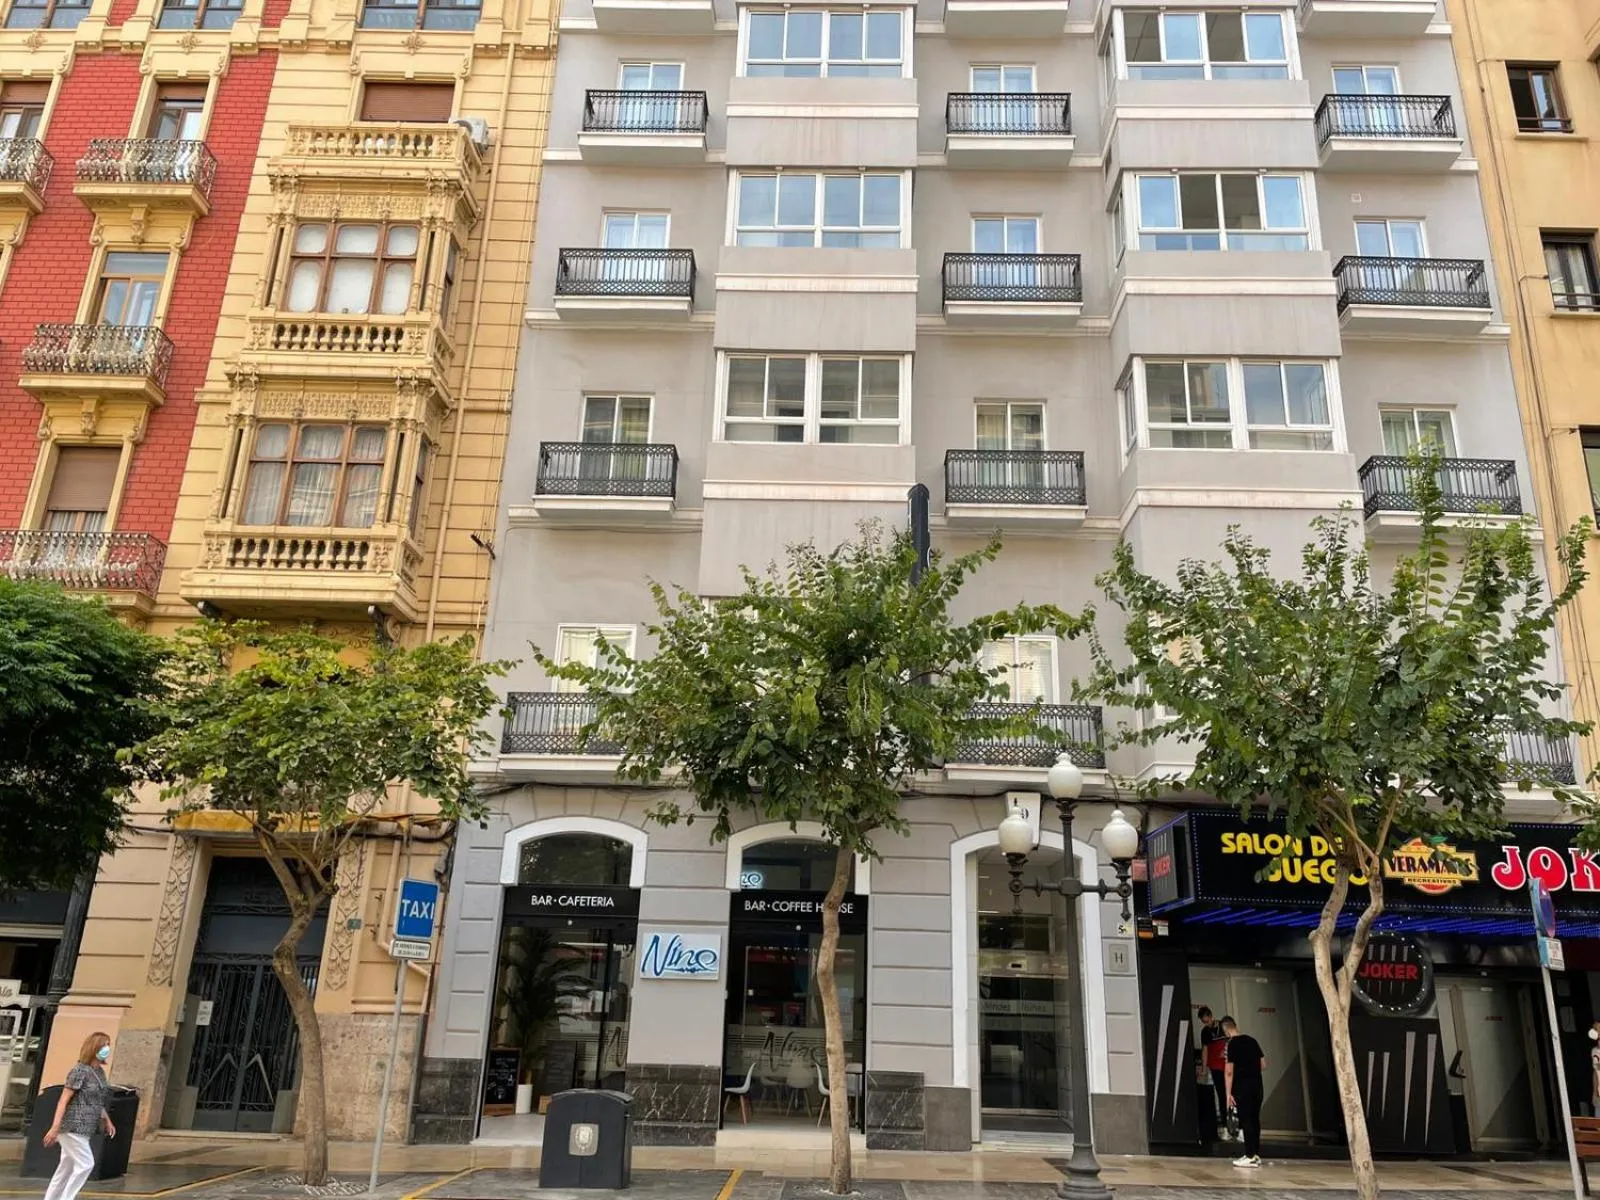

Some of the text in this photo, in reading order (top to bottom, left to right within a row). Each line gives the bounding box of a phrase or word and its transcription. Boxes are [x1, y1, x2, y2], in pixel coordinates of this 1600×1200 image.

[1221, 832, 1302, 857] SALON
[402, 899, 435, 920] TAXI
[531, 895, 615, 907] BAR CAFETERIA
[744, 900, 854, 914] BAR COFFEE HSE
[1359, 962, 1419, 980] JOKER
